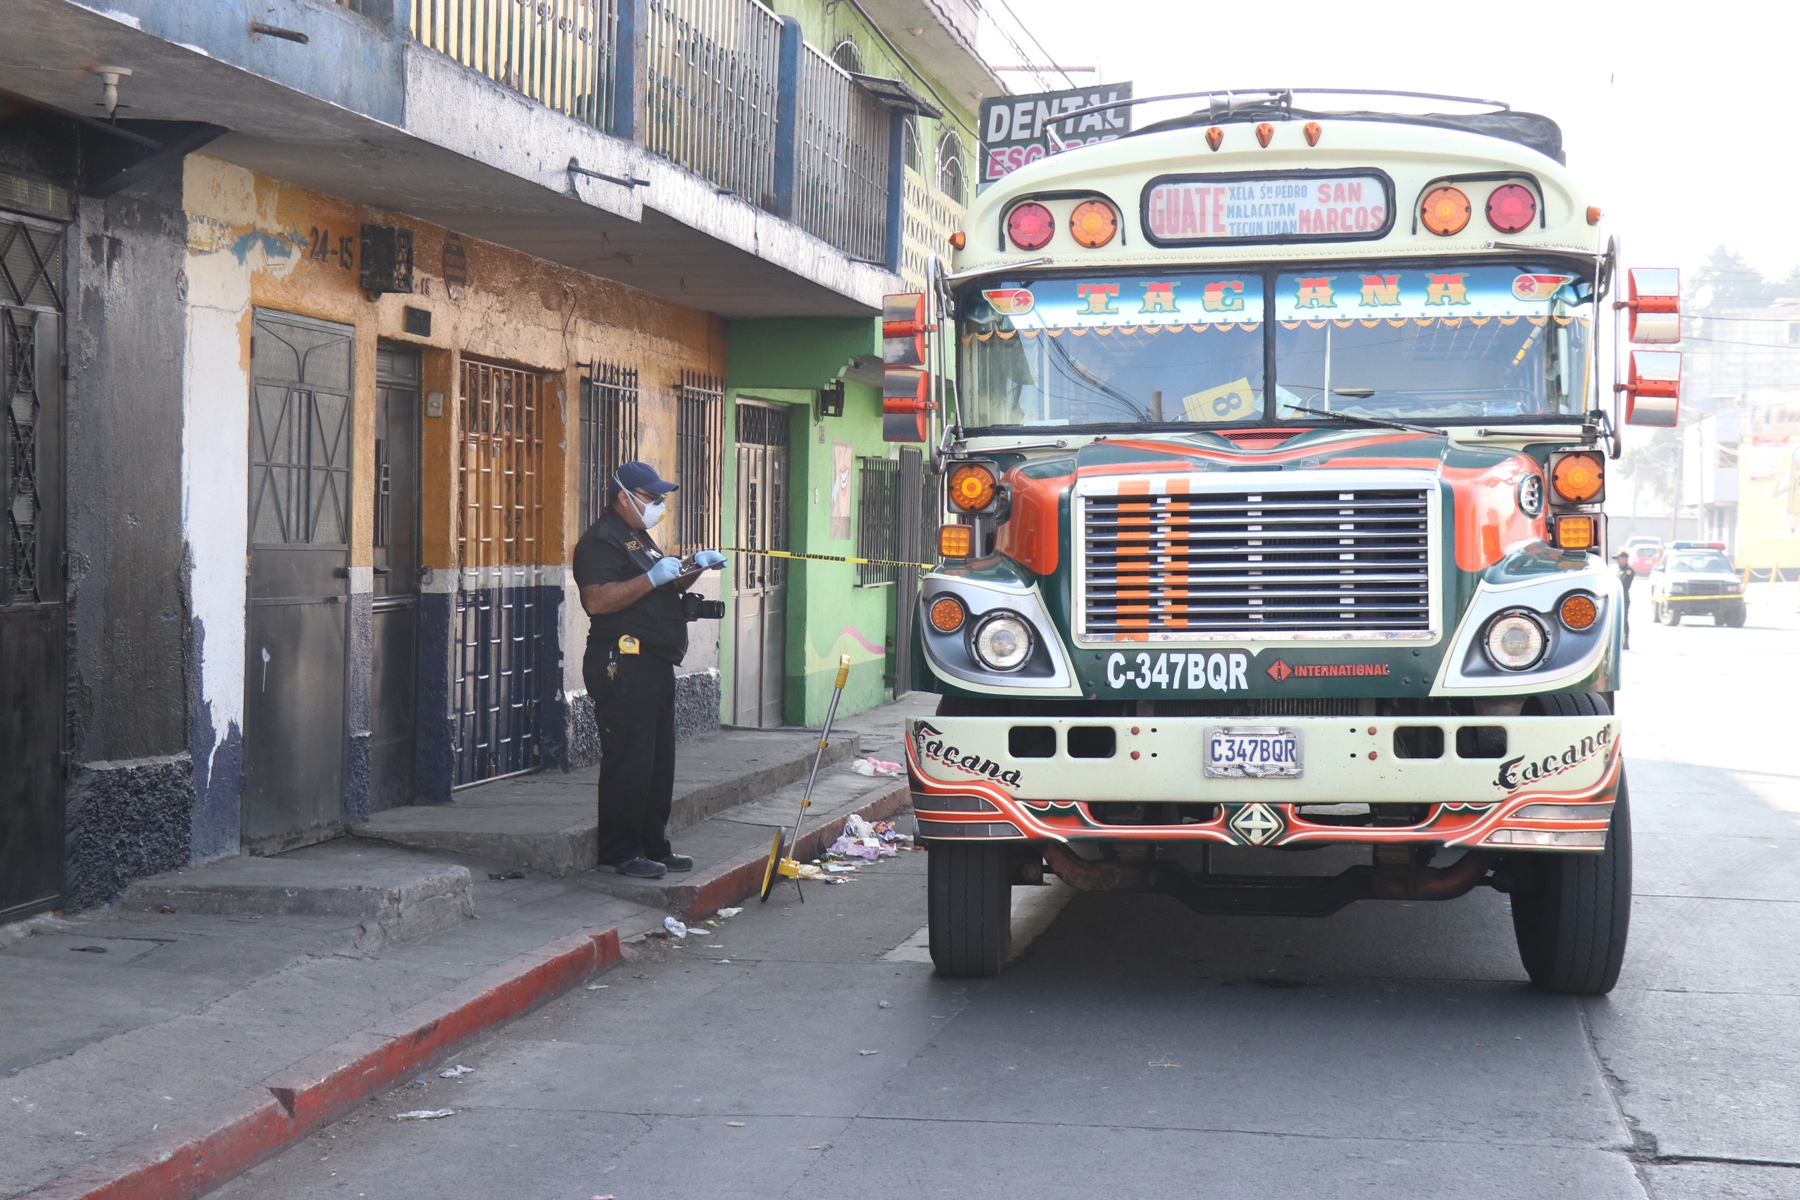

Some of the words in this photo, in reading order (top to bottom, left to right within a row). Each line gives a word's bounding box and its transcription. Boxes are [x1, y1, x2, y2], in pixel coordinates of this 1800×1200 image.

[987, 91, 1125, 143] DENTAL
[1228, 186, 1255, 201] XELA
[1275, 184, 1308, 199] PEDRO
[1317, 182, 1364, 206] SAN
[1150, 187, 1227, 238] GUATE
[1226, 202, 1296, 218] MALACATAN
[1298, 205, 1385, 234] MARCOS
[1228, 221, 1264, 236] TECUN
[1266, 220, 1298, 235] UMAN
[309, 225, 354, 271] 24-15
[1106, 652, 1249, 692] C-347BQR
[1294, 664, 1391, 678] INTERNATIONAL
[1211, 739, 1296, 762] C347BQR
